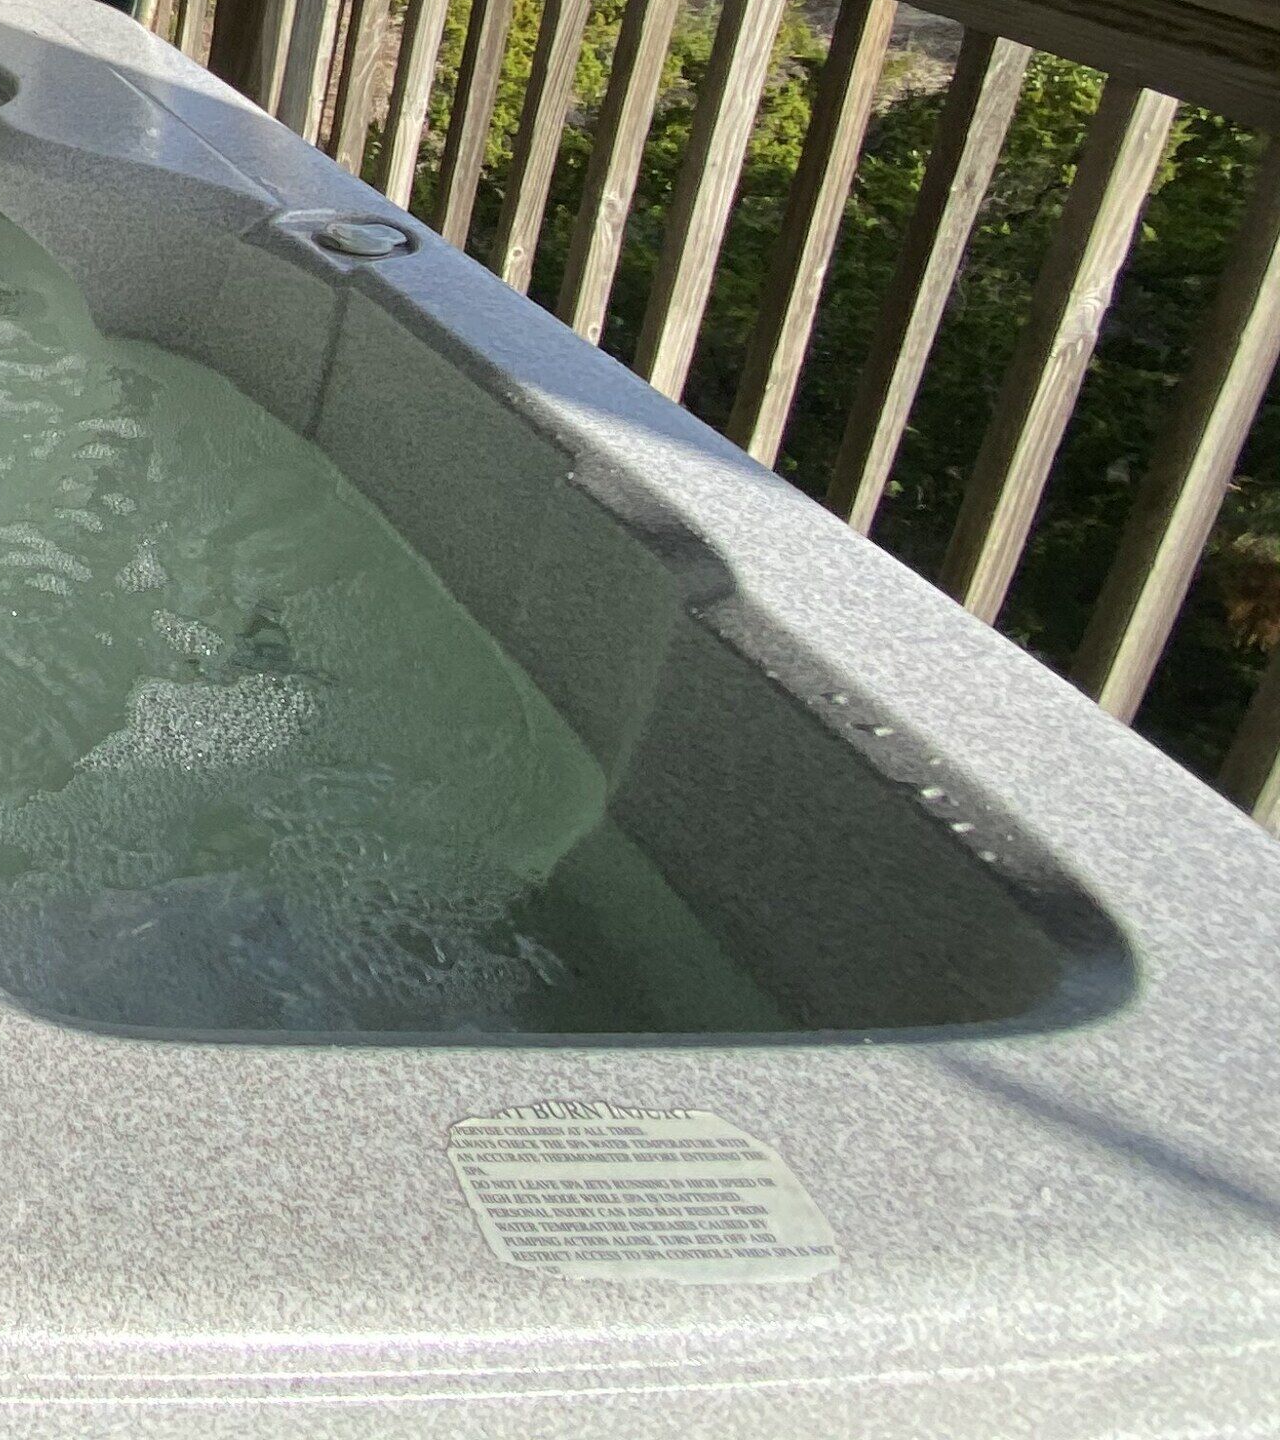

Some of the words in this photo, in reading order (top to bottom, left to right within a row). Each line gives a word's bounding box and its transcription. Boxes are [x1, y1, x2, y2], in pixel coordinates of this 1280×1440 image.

[532, 1101, 602, 1120] BURN
[450, 1126, 504, 1136] PERVISE
[504, 1126, 564, 1136] CHILDREN
[567, 1126, 581, 1135] AT
[583, 1126, 606, 1135] ALL
[497, 1140, 539, 1149] CHECK
[539, 1140, 566, 1149] THE
[566, 1140, 589, 1149] SPA
[588, 1139, 628, 1148] WATER
[629, 1139, 715, 1148] TEMPERATURE
[716, 1139, 750, 1148] WITH
[457, 1153, 475, 1162] AN
[476, 1153, 539, 1162] ACCURATE
[540, 1152, 629, 1161] THERMOMETER
[631, 1152, 679, 1161] BEFORE
[679, 1151, 741, 1160] ENTERING
[741, 1151, 770, 1160] THE
[471, 1180, 490, 1189] DO
[490, 1180, 517, 1189] NOT
[518, 1180, 559, 1189] LEAVE
[560, 1179, 583, 1188] SPA
[583, 1179, 611, 1188] JETS
[612, 1179, 670, 1188] RUNNING
[670, 1179, 684, 1188] IN
[685, 1178, 718, 1187] HIGH
[719, 1178, 756, 1187] SPEED
[757, 1178, 776, 1187] OR
[479, 1194, 511, 1203] HIGH
[512, 1194, 541, 1203] JETS
[542, 1193, 580, 1203] MODE
[580, 1193, 621, 1203] WHILE
[622, 1193, 645, 1202] SPA
[645, 1193, 659, 1202] IS
[486, 1208, 553, 1217] PERSONAL
[552, 1207, 595, 1217] INJURY
[597, 1207, 626, 1217] CAN
[627, 1207, 653, 1216] AND
[655, 1207, 683, 1216] MAY
[683, 1206, 729, 1216] RESULT
[731, 1206, 768, 1216] FROM
[495, 1222, 538, 1231] WATER
[538, 1221, 629, 1230] TEMPERATURE
[629, 1221, 698, 1230] INCREASES
[698, 1220, 748, 1229] CAUSED
[749, 1220, 767, 1229] BY
[503, 1236, 561, 1246] PUMPING
[563, 1235, 610, 1245] ACTION
[659, 1235, 694, 1244] TURN
[694, 1234, 723, 1244] JETS
[723, 1234, 747, 1243] OFF
[749, 1234, 777, 1243] AND
[511, 1251, 570, 1261] RESTRICT
[575, 1250, 622, 1260] ACCESS
[620, 1249, 640, 1259] TO
[641, 1249, 666, 1259] SPA
[665, 1248, 733, 1258] CONTROLS
[732, 1247, 772, 1257] WHEN
[772, 1247, 797, 1257] SPA
[795, 1247, 809, 1257] IS
[808, 1246, 838, 1256] NOT
